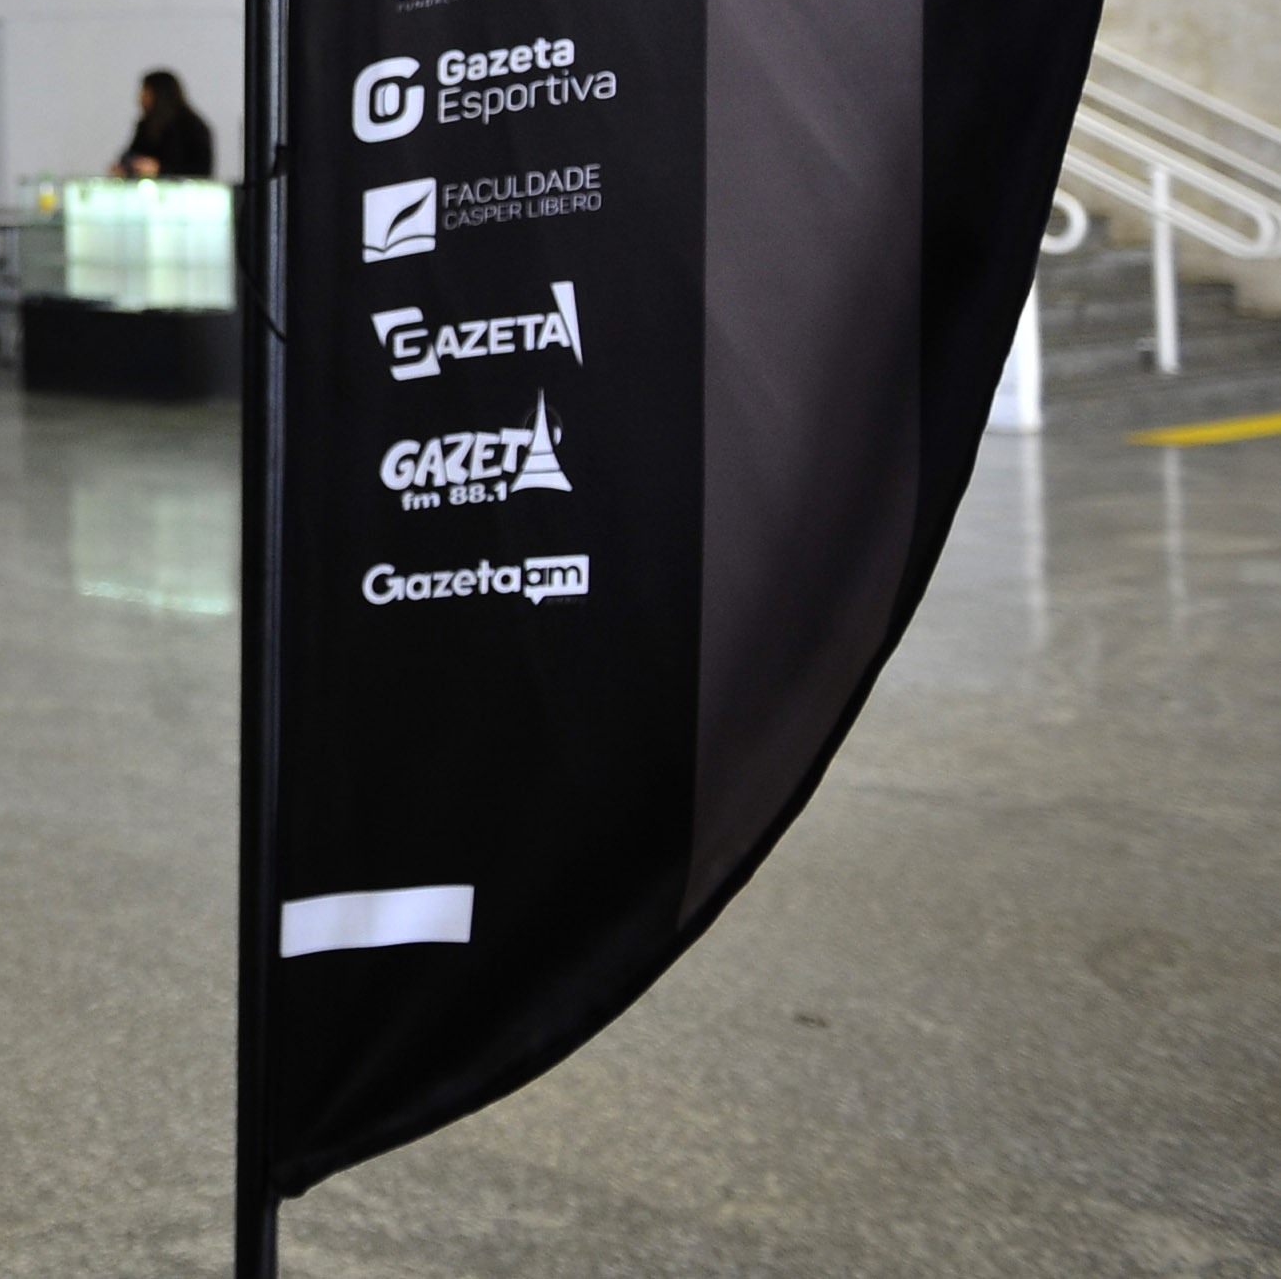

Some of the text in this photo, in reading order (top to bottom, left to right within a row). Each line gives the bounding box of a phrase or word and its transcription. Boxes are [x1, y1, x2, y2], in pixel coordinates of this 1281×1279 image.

[437, 37, 575, 86] Gazeta
[438, 69, 617, 124] Esportiva
[442, 163, 602, 209] FACULDADE
[443, 200, 523, 231] CASPER
[370, 280, 584, 381] GAZETA
[401, 480, 507, 512] fm 88.1
